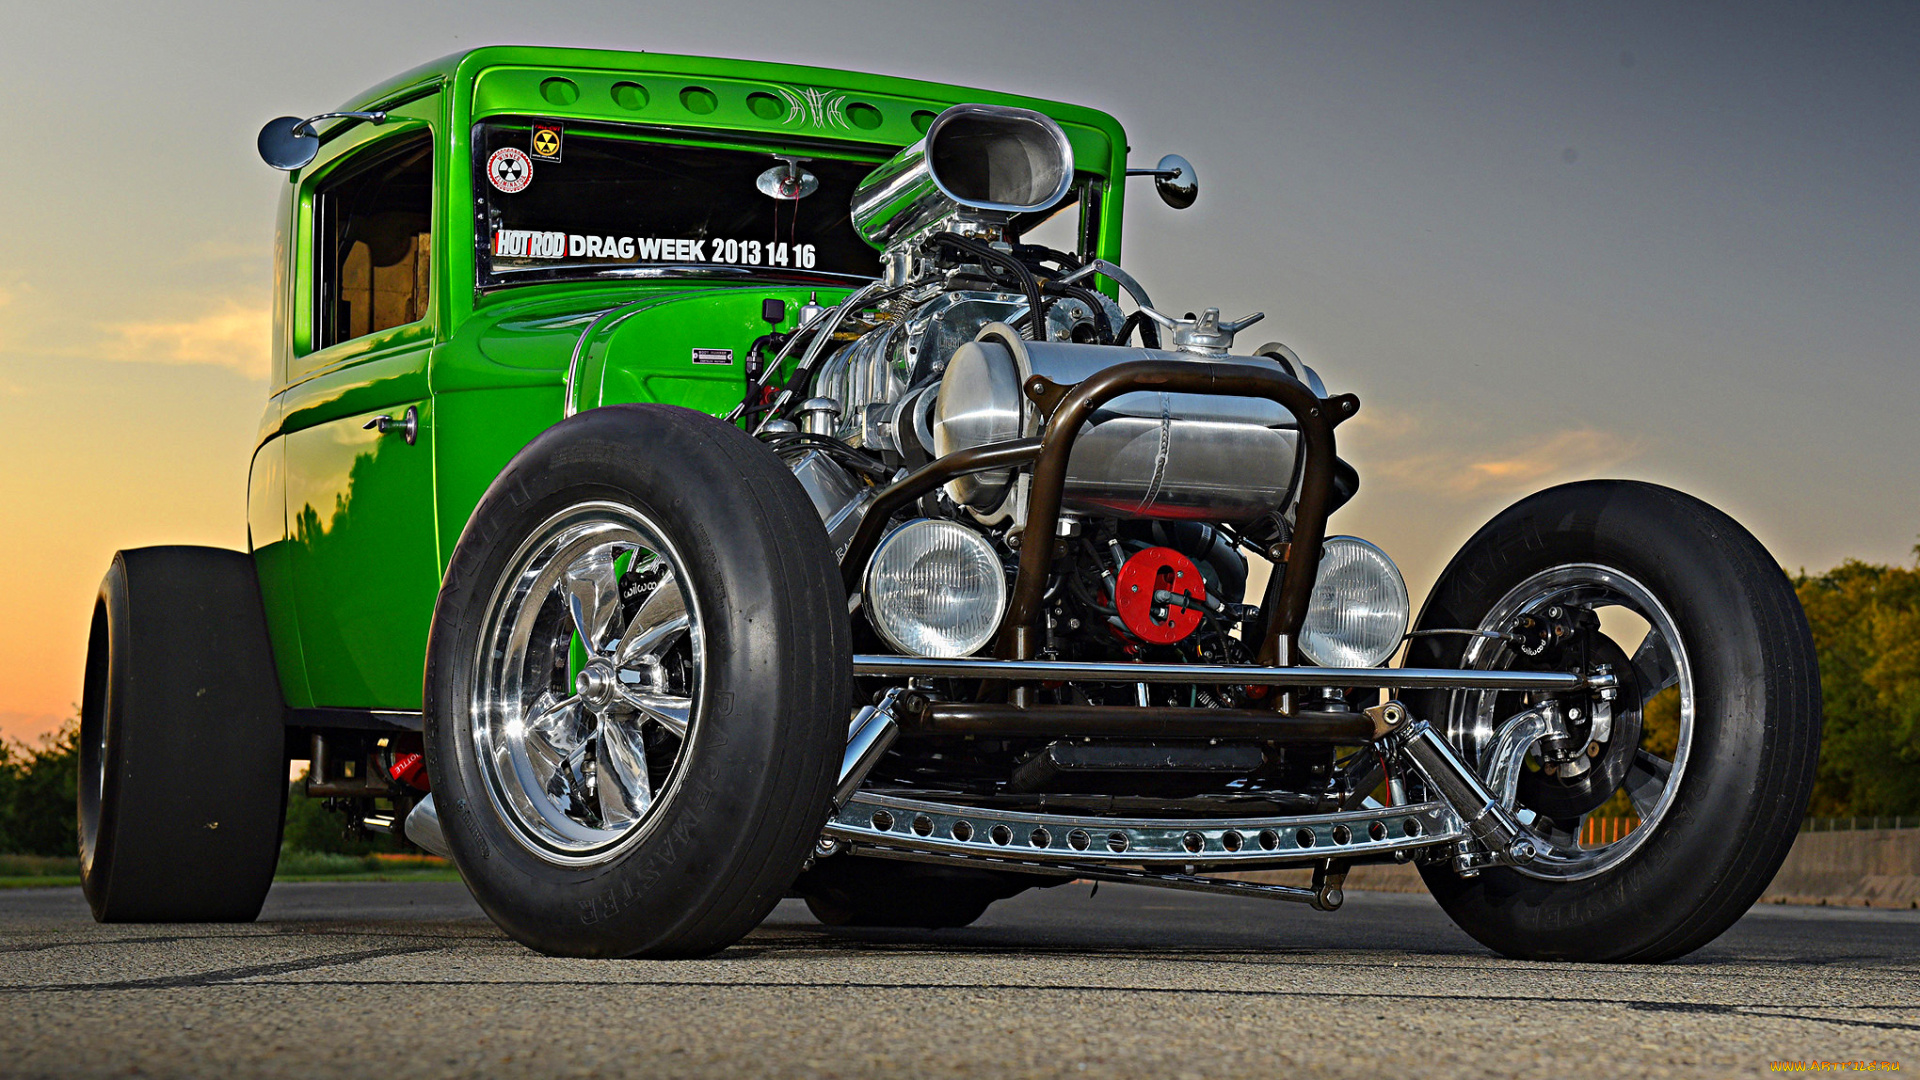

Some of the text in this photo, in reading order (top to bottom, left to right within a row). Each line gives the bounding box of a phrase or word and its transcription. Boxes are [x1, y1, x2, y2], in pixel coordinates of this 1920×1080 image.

[497, 153, 521, 161] WINNER
[495, 175, 526, 187] ELIMINATOR
[495, 230, 816, 268] HOT ROD DRAG WEEK 2013 14 16
[623, 581, 657, 598] wilwoo
